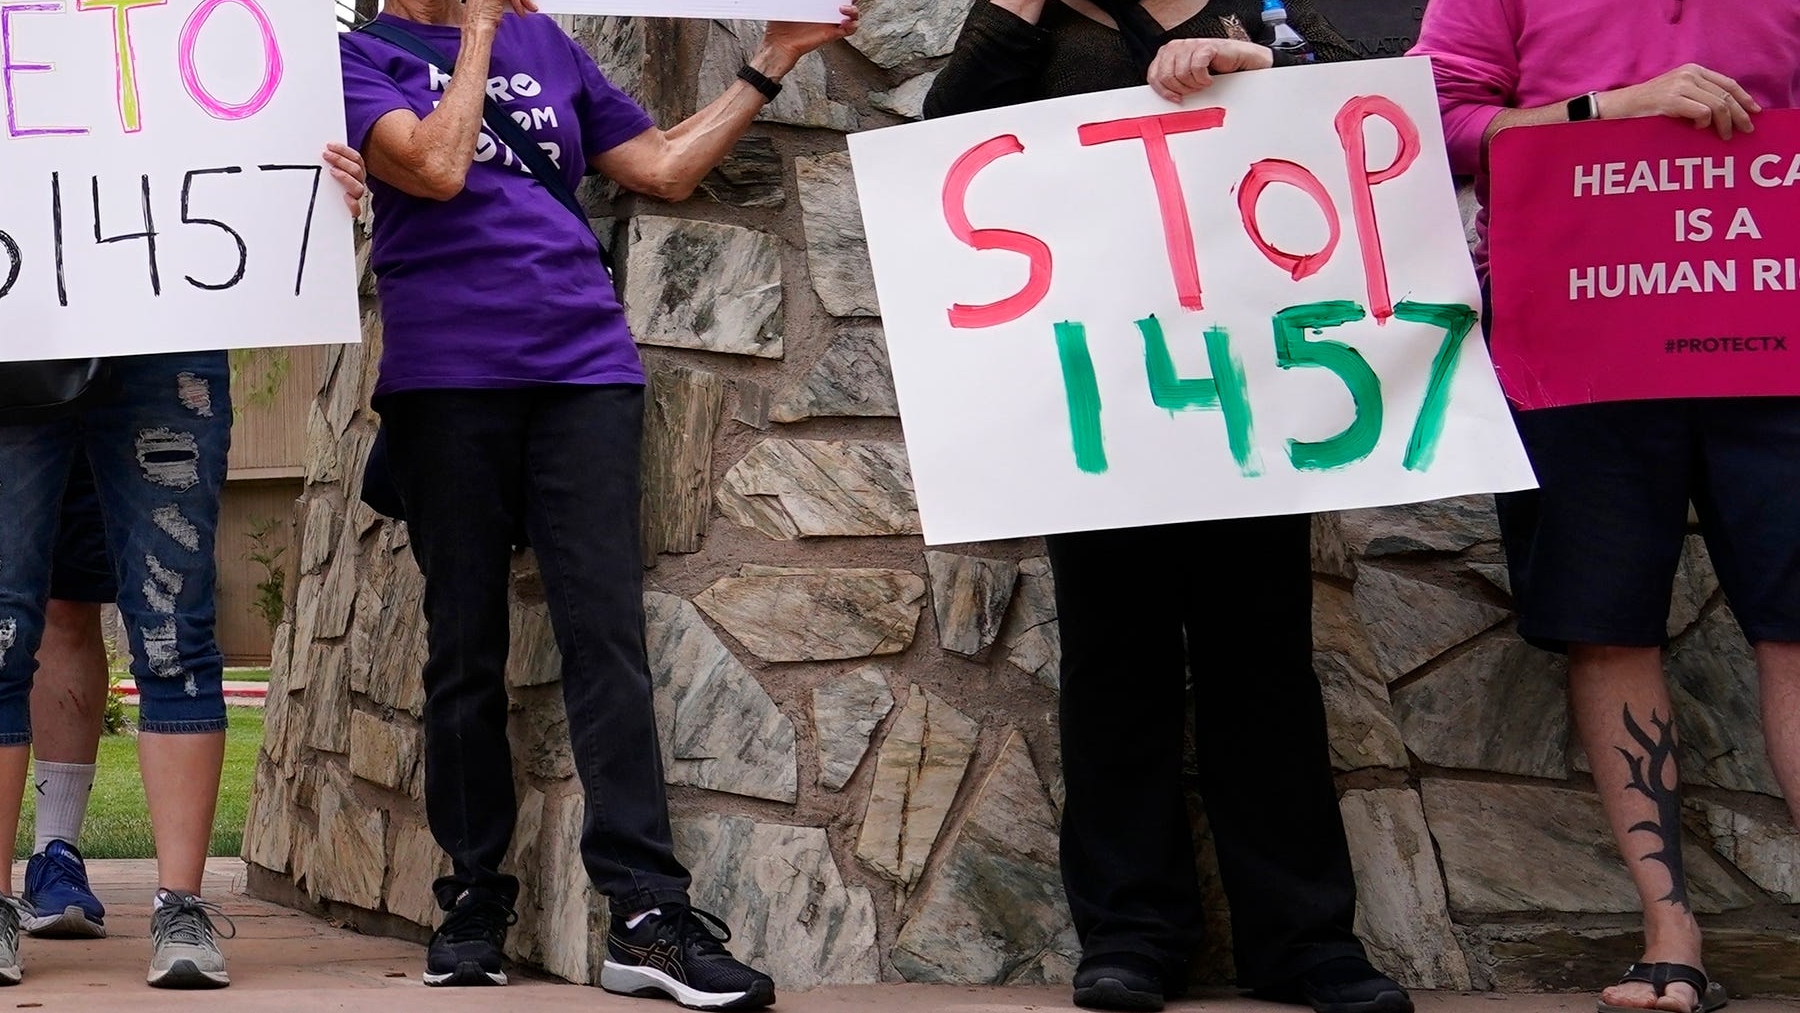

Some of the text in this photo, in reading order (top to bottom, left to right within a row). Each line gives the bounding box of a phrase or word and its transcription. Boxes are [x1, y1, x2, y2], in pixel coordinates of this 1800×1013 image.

[1573, 156, 1734, 197] HEALTH
[941, 94, 1421, 329] STOP
[1675, 207, 1762, 242] IS A
[1569, 258, 1800, 300] HUMAN RI
[1664, 336, 1787, 354] #PROTECTX
[1052, 291, 1478, 478] 1457
